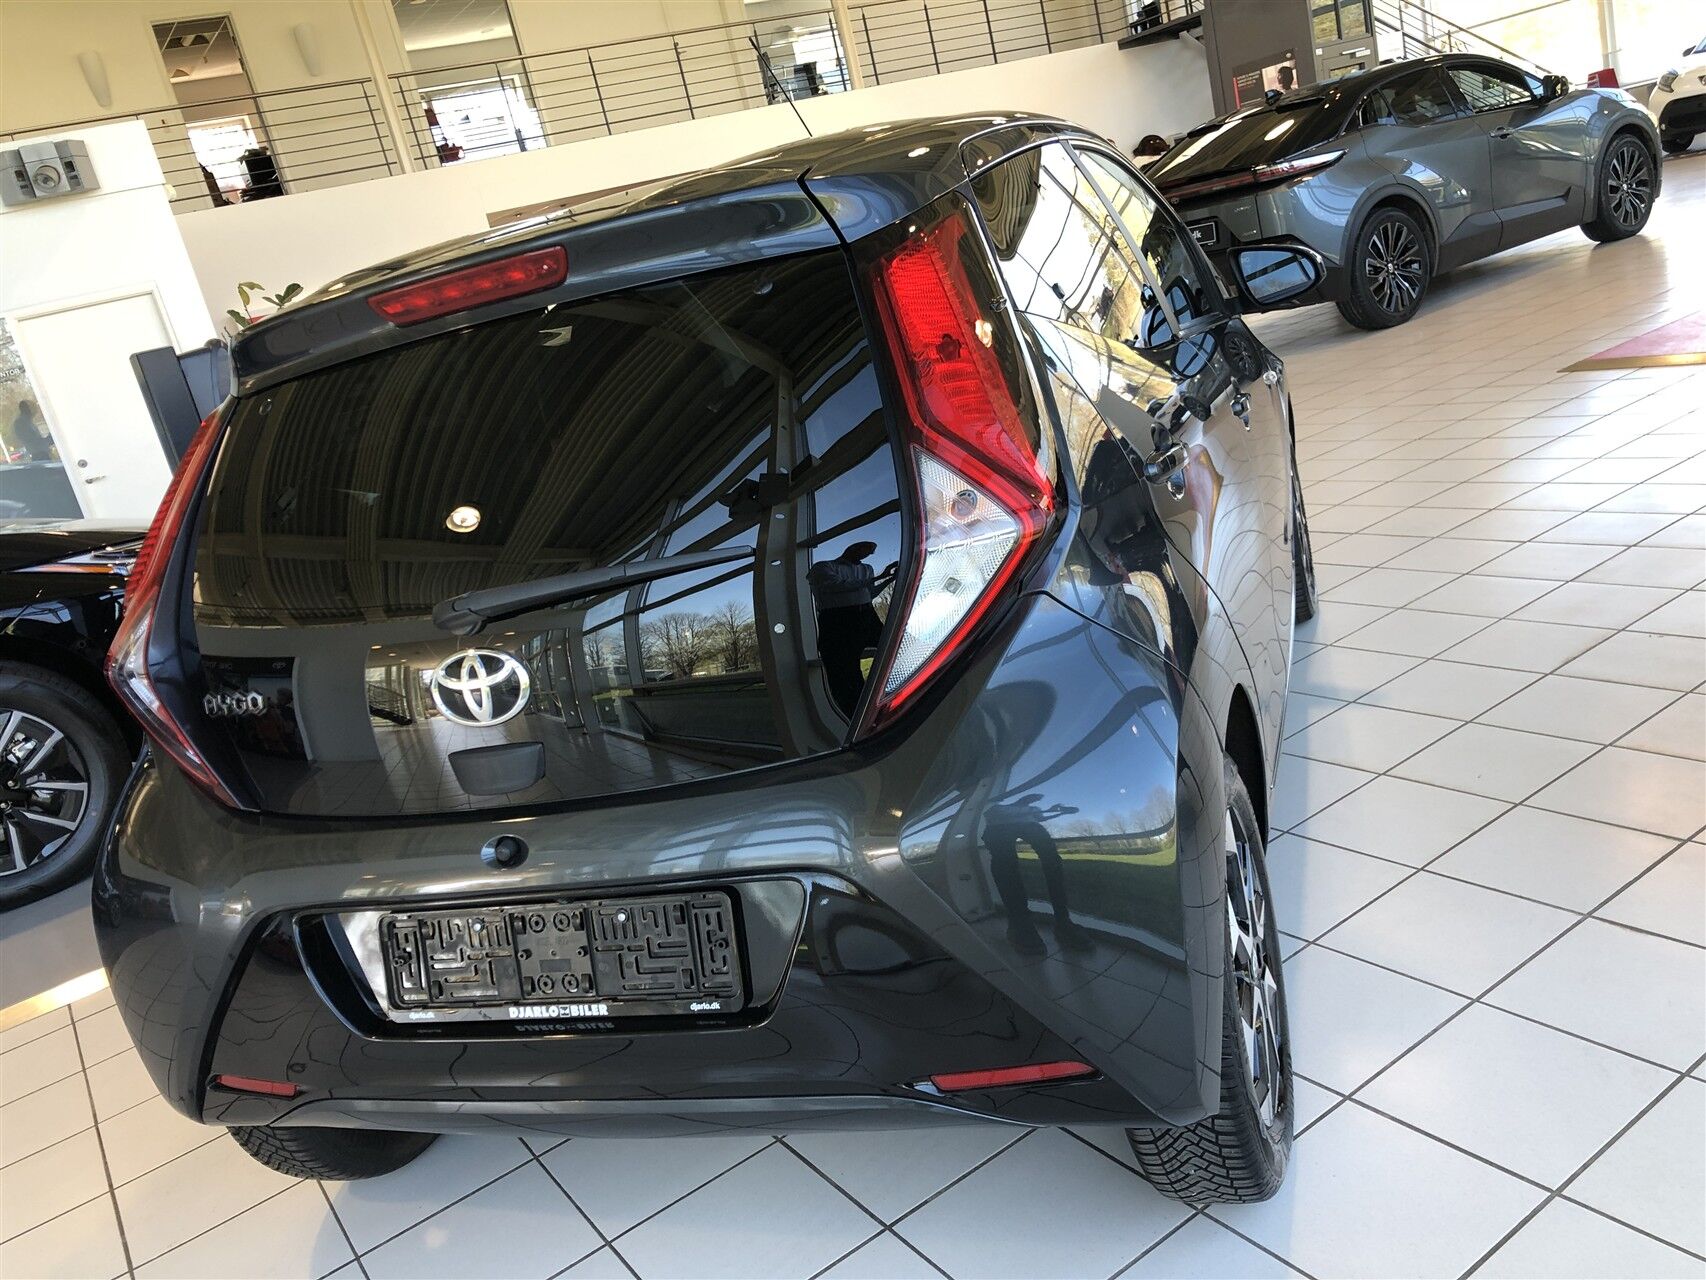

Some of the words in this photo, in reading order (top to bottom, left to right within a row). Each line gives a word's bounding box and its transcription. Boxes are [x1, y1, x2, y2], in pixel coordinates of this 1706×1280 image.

[203, 691, 264, 715] AYGO
[508, 1006, 559, 1018] DJARLO
[570, 1004, 609, 1016] BILER
[690, 1002, 721, 1012] djarlo.dk
